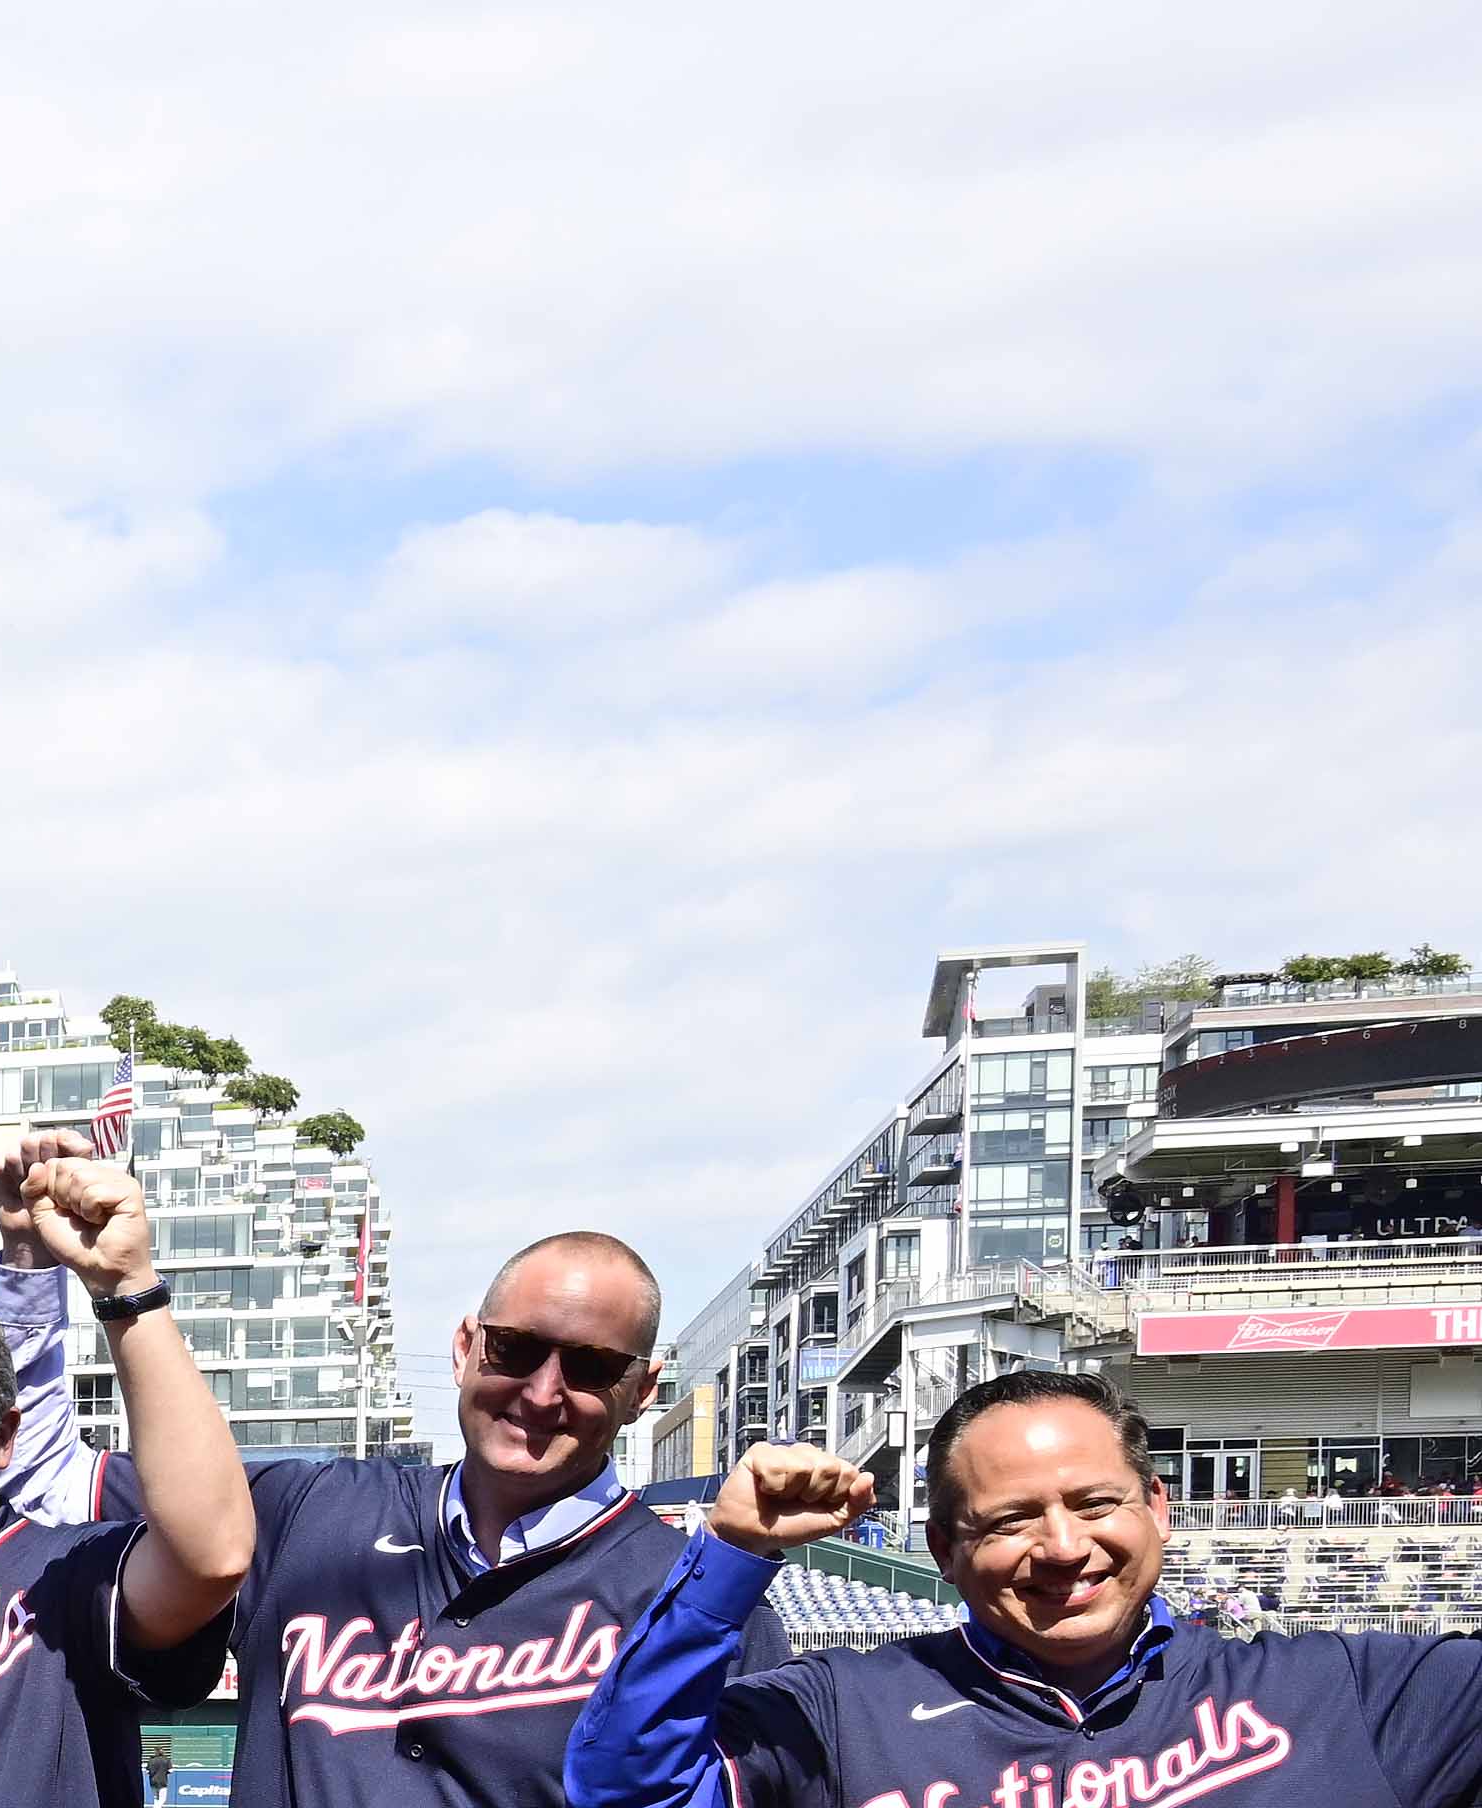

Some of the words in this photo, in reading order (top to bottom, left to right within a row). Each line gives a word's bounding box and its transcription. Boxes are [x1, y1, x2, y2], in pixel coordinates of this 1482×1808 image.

[1409, 1024, 1418, 1034] 7
[1458, 1019, 1467, 1029] 8
[1362, 1029, 1371, 1039] 6
[1321, 1036, 1329, 1045] 5
[1238, 1321, 1337, 1342] Budweiser
[280, 1600, 623, 1737] Nationals
[179, 1783, 232, 1798] Capita
